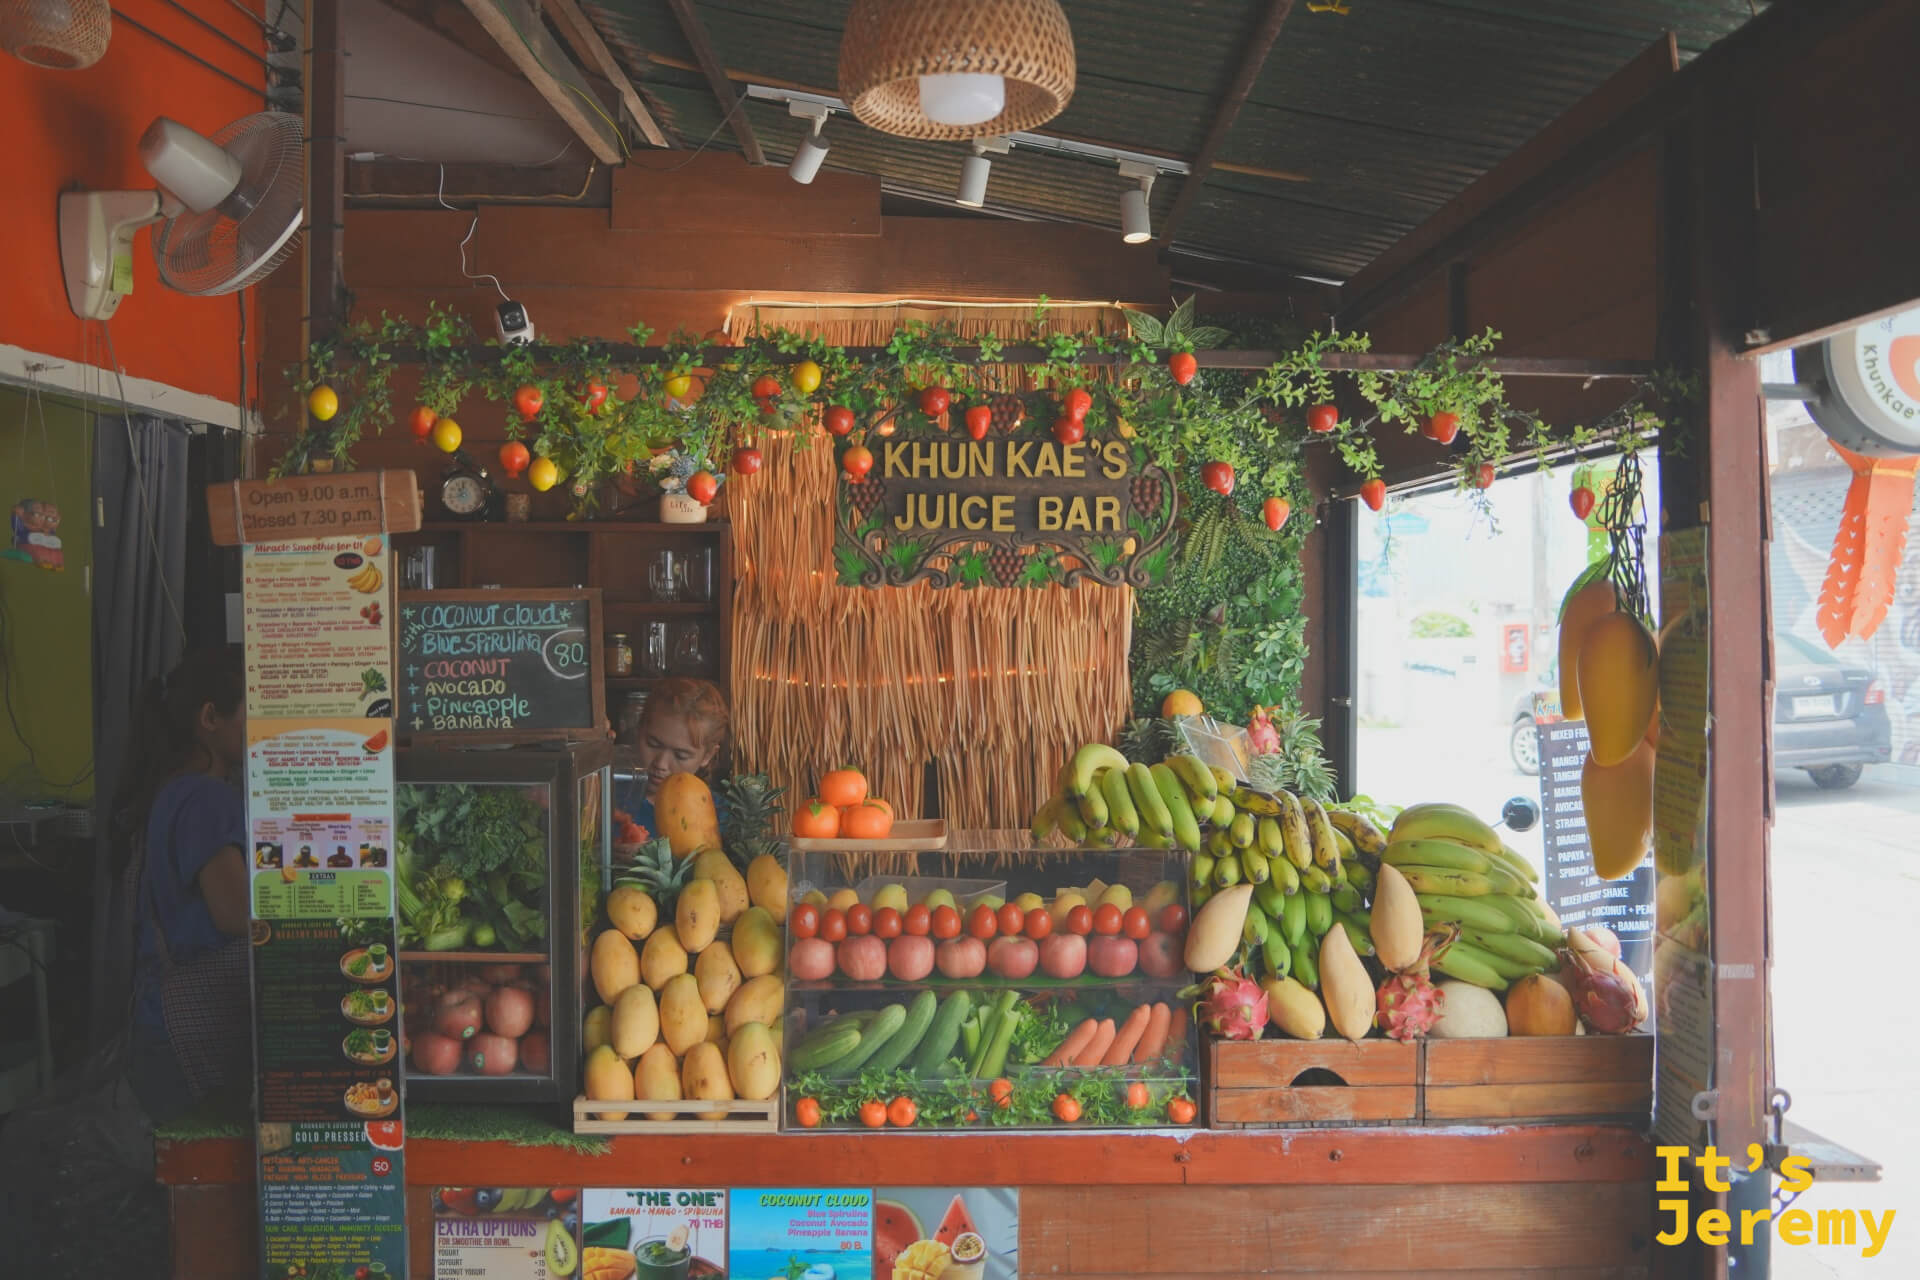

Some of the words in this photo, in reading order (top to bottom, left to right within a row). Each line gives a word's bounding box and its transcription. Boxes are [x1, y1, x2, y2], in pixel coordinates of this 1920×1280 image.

[884, 440, 994, 479] KHUN
[1006, 438, 1128, 480] KAE'S
[248, 489, 294, 508] Open
[298, 485, 335, 501] 9.00
[338, 485, 375, 499] a.m.
[242, 511, 297, 530] Closed
[301, 509, 337, 525] 7.30
[341, 506, 377, 526] p.m.
[894, 492, 1016, 532] JUICE
[1038, 495, 1122, 532] BAR
[421, 604, 499, 628] COCONUT
[503, 603, 560, 626] cloud
[422, 632, 461, 655] Blue
[424, 658, 511, 679] COCONUT
[1558, 850, 1585, 863] PAPAYA
[1601, 887, 1630, 898] SHAKE
[1591, 904, 1627, 917] COCONUT
[1617, 920, 1650, 932] BANANA
[295, 1132, 320, 1143] COLD
[324, 1131, 368, 1143] PRESSED
[373, 1161, 389, 1172] 50
[759, 1193, 822, 1208] COCONUT
[825, 1193, 869, 1208] CLOUD
[609, 1207, 642, 1216] BANANA
[648, 1207, 677, 1216] MANGO
[683, 1206, 724, 1216] SPIRULINA
[807, 1210, 826, 1218] Blue
[828, 1209, 869, 1219] Spirulina
[438, 1219, 480, 1237] EXTRA
[482, 1220, 537, 1237] OPTIONS
[788, 1219, 827, 1228] Coconut
[829, 1219, 869, 1228] Avocado
[787, 1229, 832, 1238] Pineapple
[834, 1228, 869, 1237] Banana
[438, 1237, 451, 1247] FOR
[451, 1237, 483, 1247] SMOOTHIE
[437, 1268, 464, 1276] COCONUT
